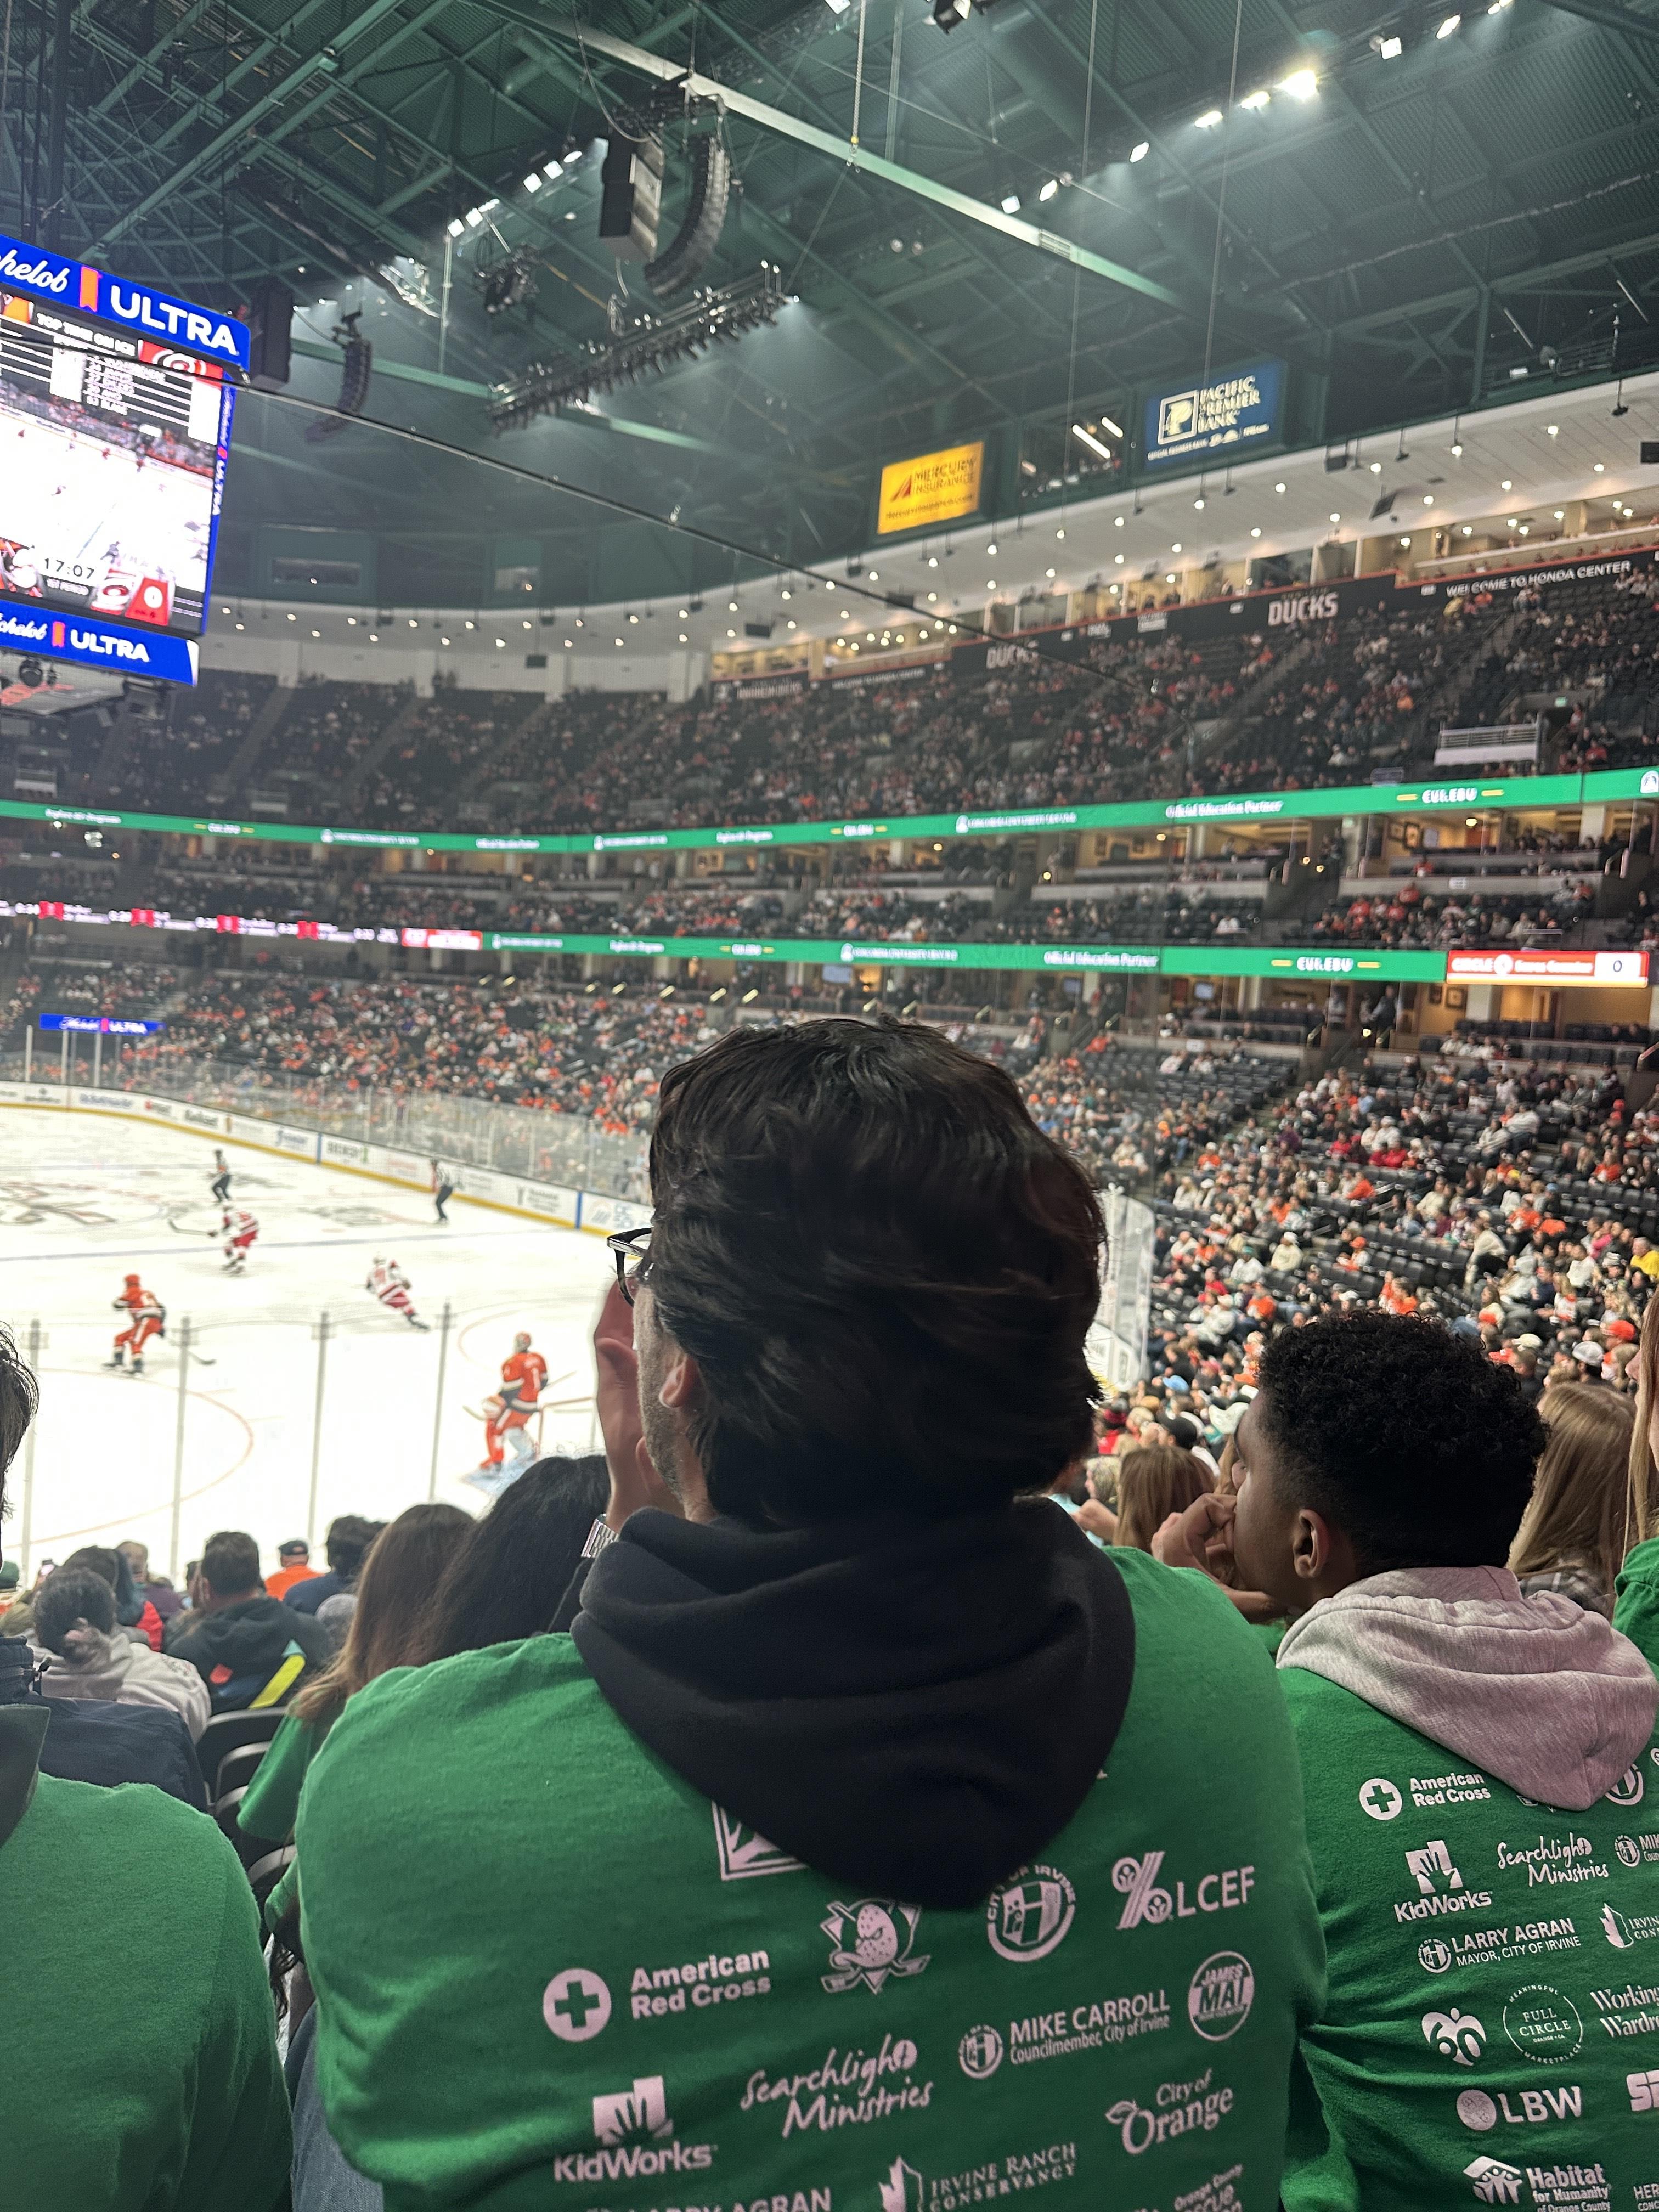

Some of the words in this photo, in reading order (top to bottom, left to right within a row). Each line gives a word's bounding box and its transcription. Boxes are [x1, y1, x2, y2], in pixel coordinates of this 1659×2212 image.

[0, 249, 70, 292] helob
[110, 285, 240, 356] ULTRA
[1199, 375, 1255, 404] PACIFIC
[1199, 388, 1260, 416] PREMIER
[44, 558, 95, 579] 17:07
[1446, 577, 1508, 597] WELCOME
[1510, 574, 1526, 588] TO
[1528, 568, 1575, 586] HONDA
[1577, 560, 1632, 579] CENTER
[1268, 591, 1339, 627] DUCKS
[70, 629, 150, 663] ULTRA
[1612, 960, 1623, 973] 0
[1410, 1773, 1484, 1791] American
[1412, 1792, 1446, 1807] Red
[1446, 1787, 1491, 1803] Cross
[1527, 1860, 1609, 1888] Ministries
[1176, 1865, 1255, 1917] LCEF
[1393, 1891, 1492, 1923] KidWorks
[1451, 1928, 1508, 1953] LARRY
[1515, 1918, 1575, 1942] AGRAN
[1634, 1927, 1659, 1939] CON
[1456, 1949, 1502, 1967] MAYOR,
[1502, 1944, 1527, 1960] CITY
[1528, 1943, 1544, 1954] OF
[1546, 1936, 1581, 1950] IRVINE
[630, 1950, 770, 1993] American
[631, 1988, 686, 2019] Red
[691, 1977, 771, 2007] Cross
[1509, 1984, 1558, 2003] MEANINGFUL
[1009, 2011, 1067, 2045] MIKE
[1073, 1989, 1170, 2031] CARROLL
[1104, 2024, 1126, 2044] City
[1126, 2021, 1139, 2037] of
[1140, 2013, 1170, 2033] Irvine
[1519, 2020, 1571, 2036] CIRCLE
[1522, 2008, 1557, 2022] FULL
[1524, 2043, 1581, 2064] MARKETPLACE
[782, 2076, 934, 2138] Ministries
[1156, 2083, 1193, 2106] City
[1497, 2086, 1582, 2123] LBW
[1122, 2087, 1233, 2154] Orange
[554, 2141, 713, 2181] KidWorks
[932, 2163, 997, 2197] IRVINE
[1006, 2141, 1077, 2174] RANCH
[1526, 2163, 1606, 2189] Habitat
[929, 2162, 1077, 2212] CONSERVANCY
[1532, 2190, 1550, 2203] for
[1553, 2186, 1609, 2201] Humanity
